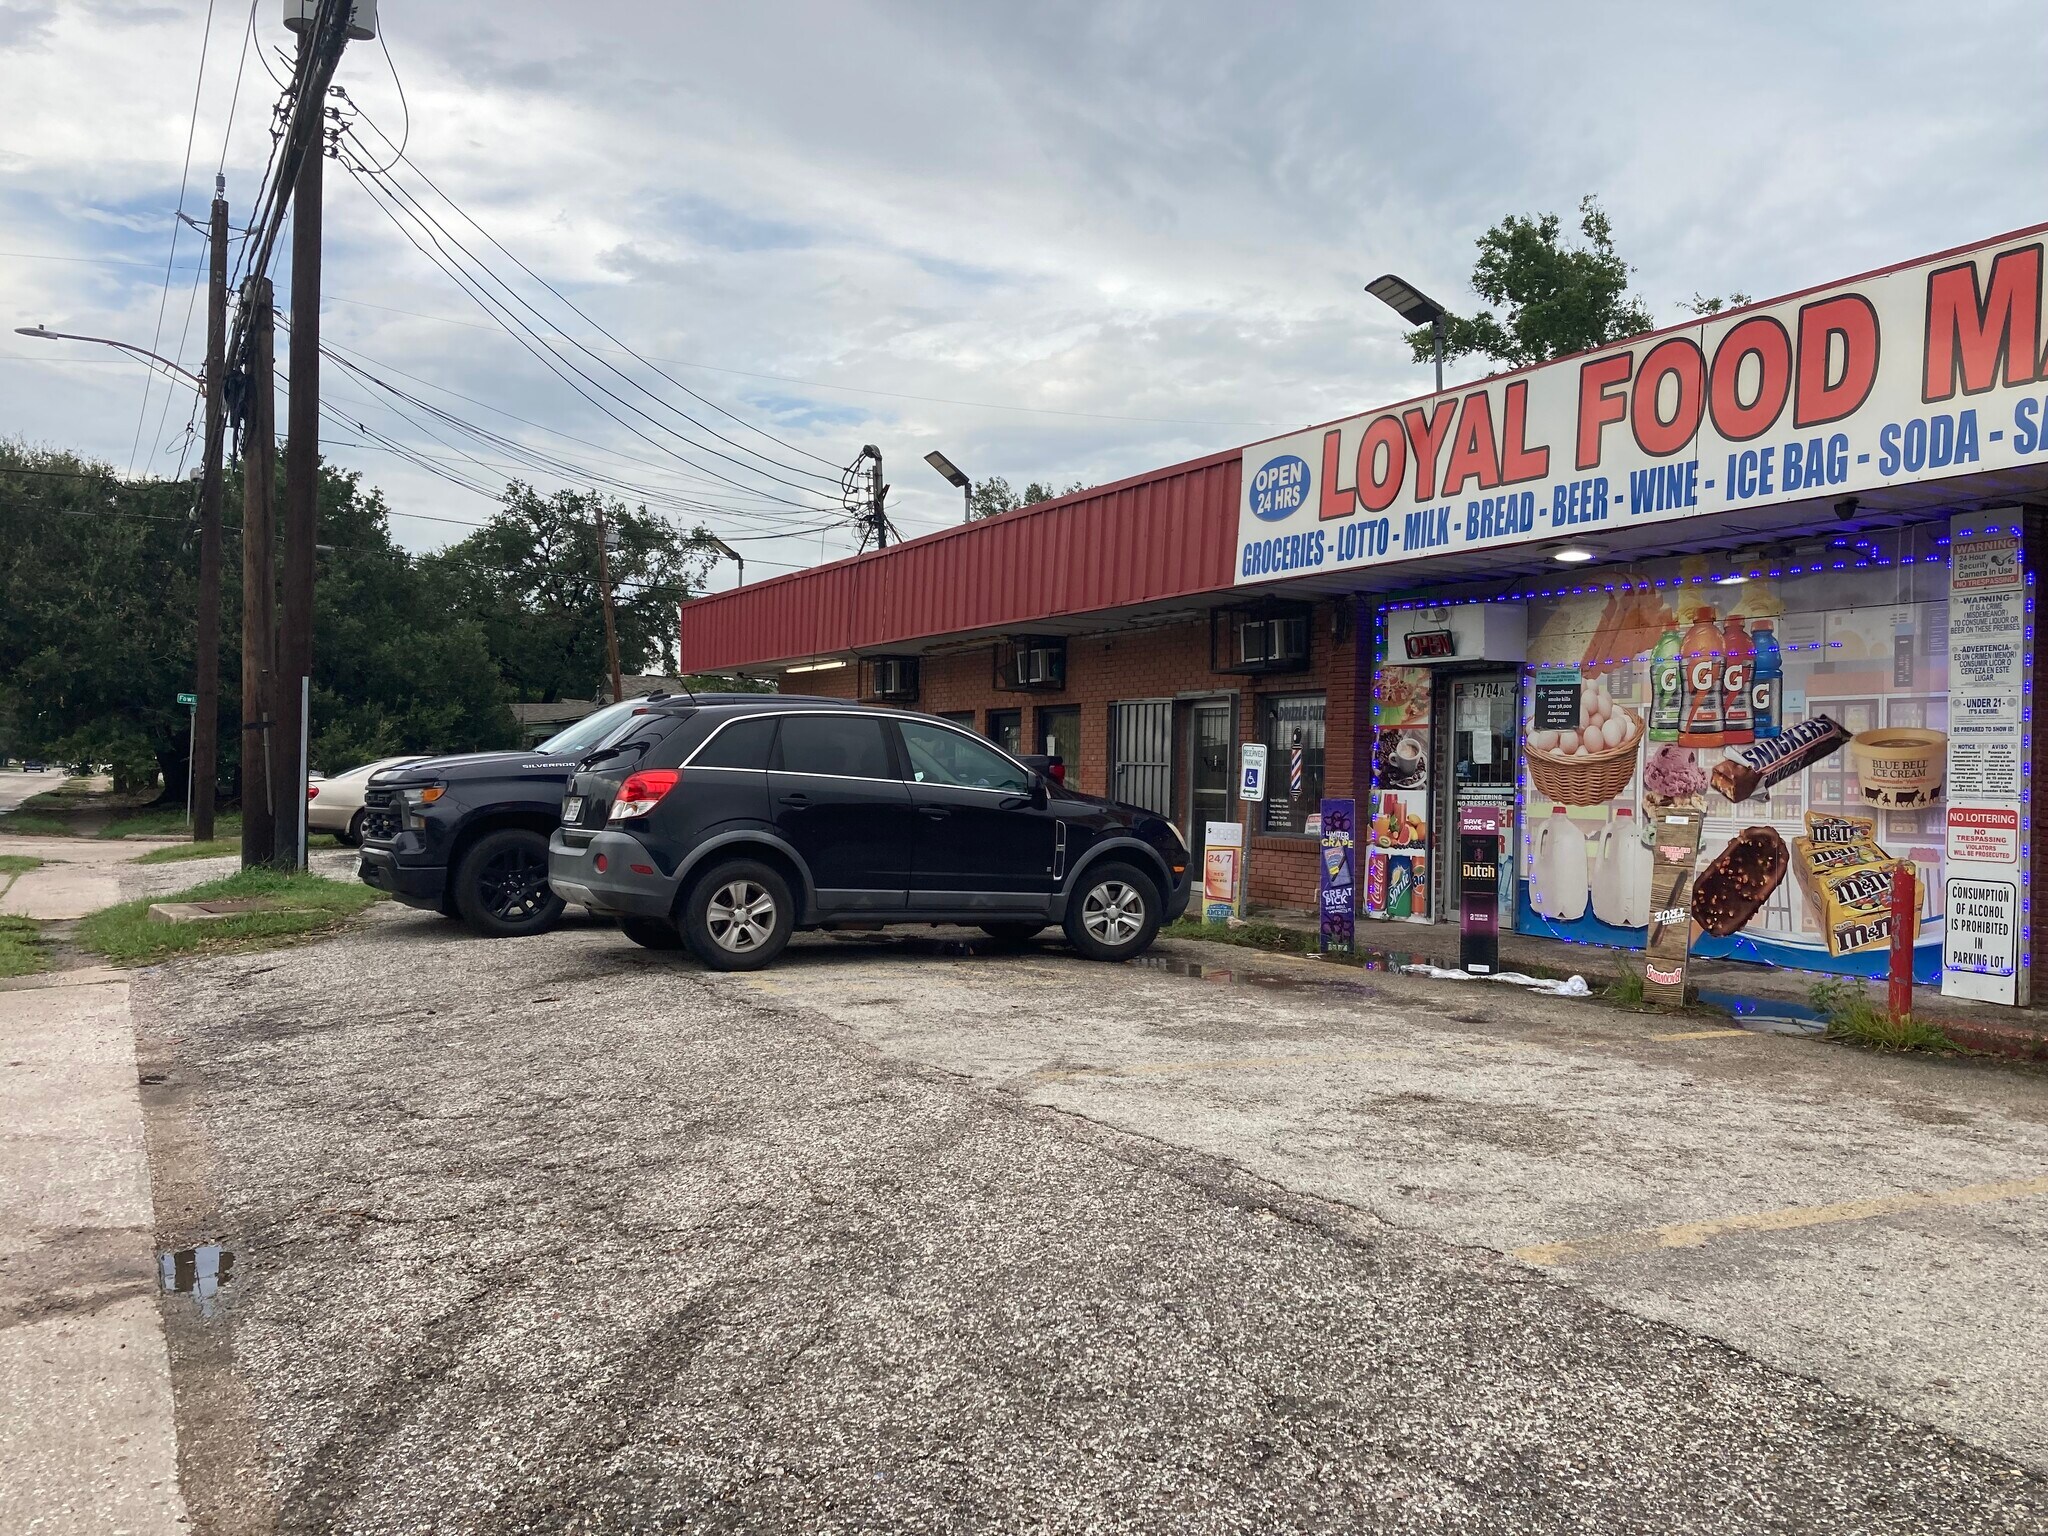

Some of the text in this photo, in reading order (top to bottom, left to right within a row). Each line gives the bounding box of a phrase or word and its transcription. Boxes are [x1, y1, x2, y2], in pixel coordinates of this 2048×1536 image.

[1318, 243, 2048, 522] LOYAL FOOD M
[1256, 461, 1303, 491] OPEN
[1242, 529, 1324, 577] GROCERIES
[1337, 517, 1389, 562] LOTTO
[1403, 506, 1451, 551] MILK
[1465, 491, 1534, 541] BREAD
[1552, 477, 1608, 527] BEER
[1630, 460, 1699, 515] WINE
[1726, 446, 1775, 501] ICE
[1782, 433, 1849, 492] BAG
[1879, 409, 1980, 477] SODA
[1257, 485, 1301, 514] 24 HRS
[1956, 539, 2016, 554] WARNING
[1959, 561, 1989, 570] Security
[1968, 576, 2015, 587] TRESPASSING
[1986, 602, 2003, 610] CRIME
[1962, 618, 1988, 626] CONSUME
[1989, 617, 2009, 625] LIQUOR
[1406, 634, 1452, 657] OPEN
[1692, 661, 1713, 690] G
[1723, 664, 1743, 692] G
[1961, 667, 1986, 675] CERVEZA
[1661, 668, 1677, 692] G
[1752, 683, 1770, 709] G
[1966, 698, 2001, 708] UNDER 21
[1741, 719, 1834, 772] SNICKERS
[1872, 759, 1928, 769] BLUE BELL
[1873, 768, 1926, 778] ICE CREAM
[1486, 820, 1496, 830] 2
[1949, 813, 2015, 824] NO LOITERING
[1321, 839, 1354, 849] GRAPE
[1956, 835, 2007, 843] TRESPASSING
[1208, 854, 1232, 864] 24/7
[1462, 863, 1495, 878] Dutch
[1322, 887, 1353, 899] GREAT
[1389, 873, 1410, 905] Sprite
[1952, 886, 2009, 902] CONSUMPTION
[1325, 896, 1348, 906] PICK
[1207, 909, 1234, 917] AMERICA
[1654, 907, 1686, 922] TRUE
[1956, 902, 2004, 918] OF ALCOHOL
[1951, 918, 2009, 935] IS PROHIBITED
[1974, 937, 1983, 949] IN
[1953, 951, 2004, 968] PARKING LOT
